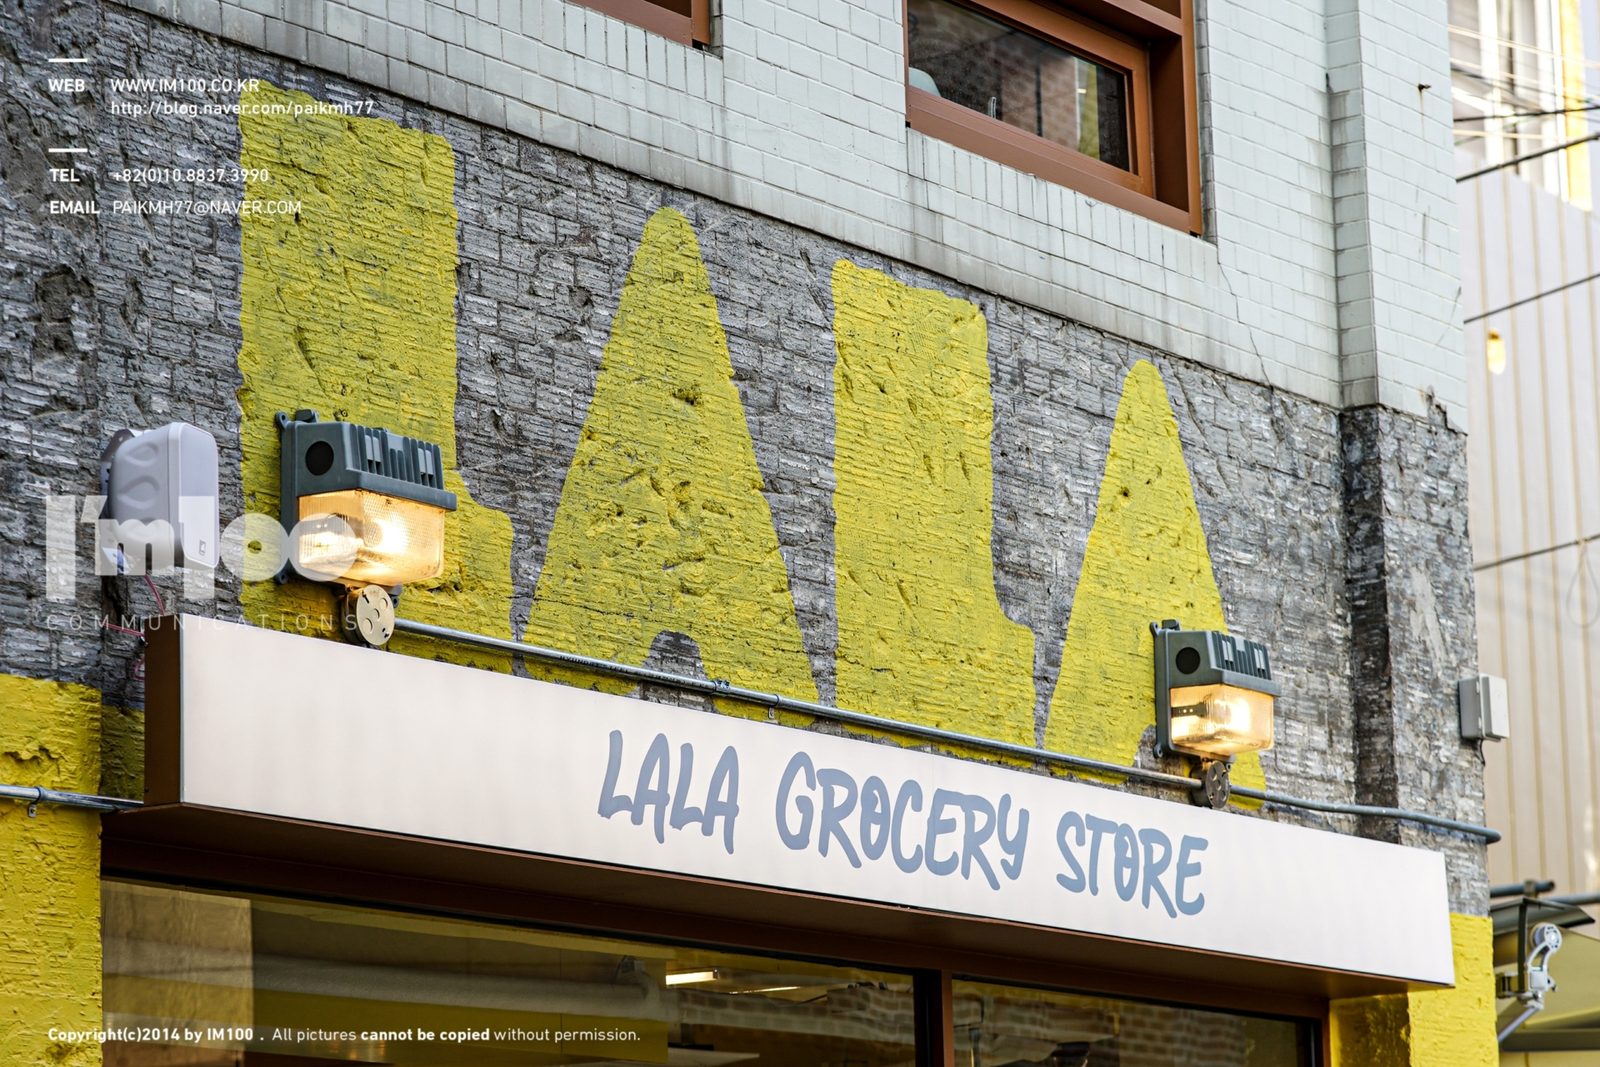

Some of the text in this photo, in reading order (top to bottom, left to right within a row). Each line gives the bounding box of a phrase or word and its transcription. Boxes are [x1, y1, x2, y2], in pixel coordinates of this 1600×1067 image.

[235, 80, 1266, 812] LALA
[597, 729, 1209, 918] LALA GROCERY STORE
